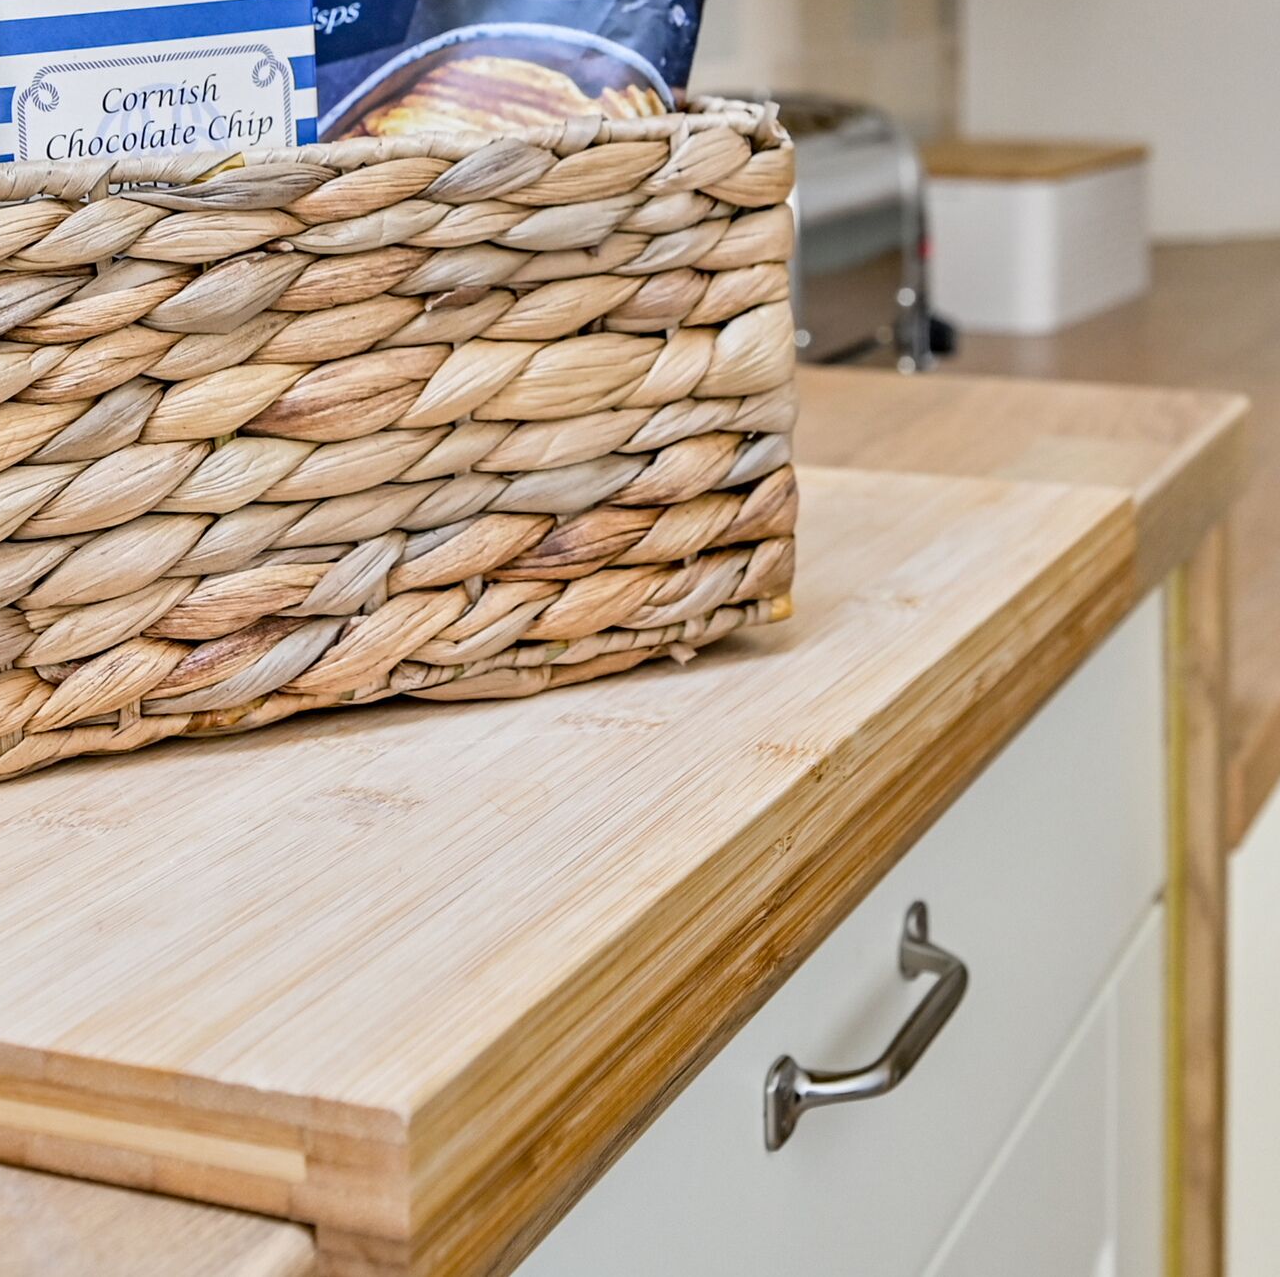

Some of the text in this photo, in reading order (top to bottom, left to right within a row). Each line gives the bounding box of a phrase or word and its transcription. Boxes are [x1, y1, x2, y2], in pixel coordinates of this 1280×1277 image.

[102, 73, 221, 114] Cornish
[45, 109, 274, 161] Chocolate Chip
